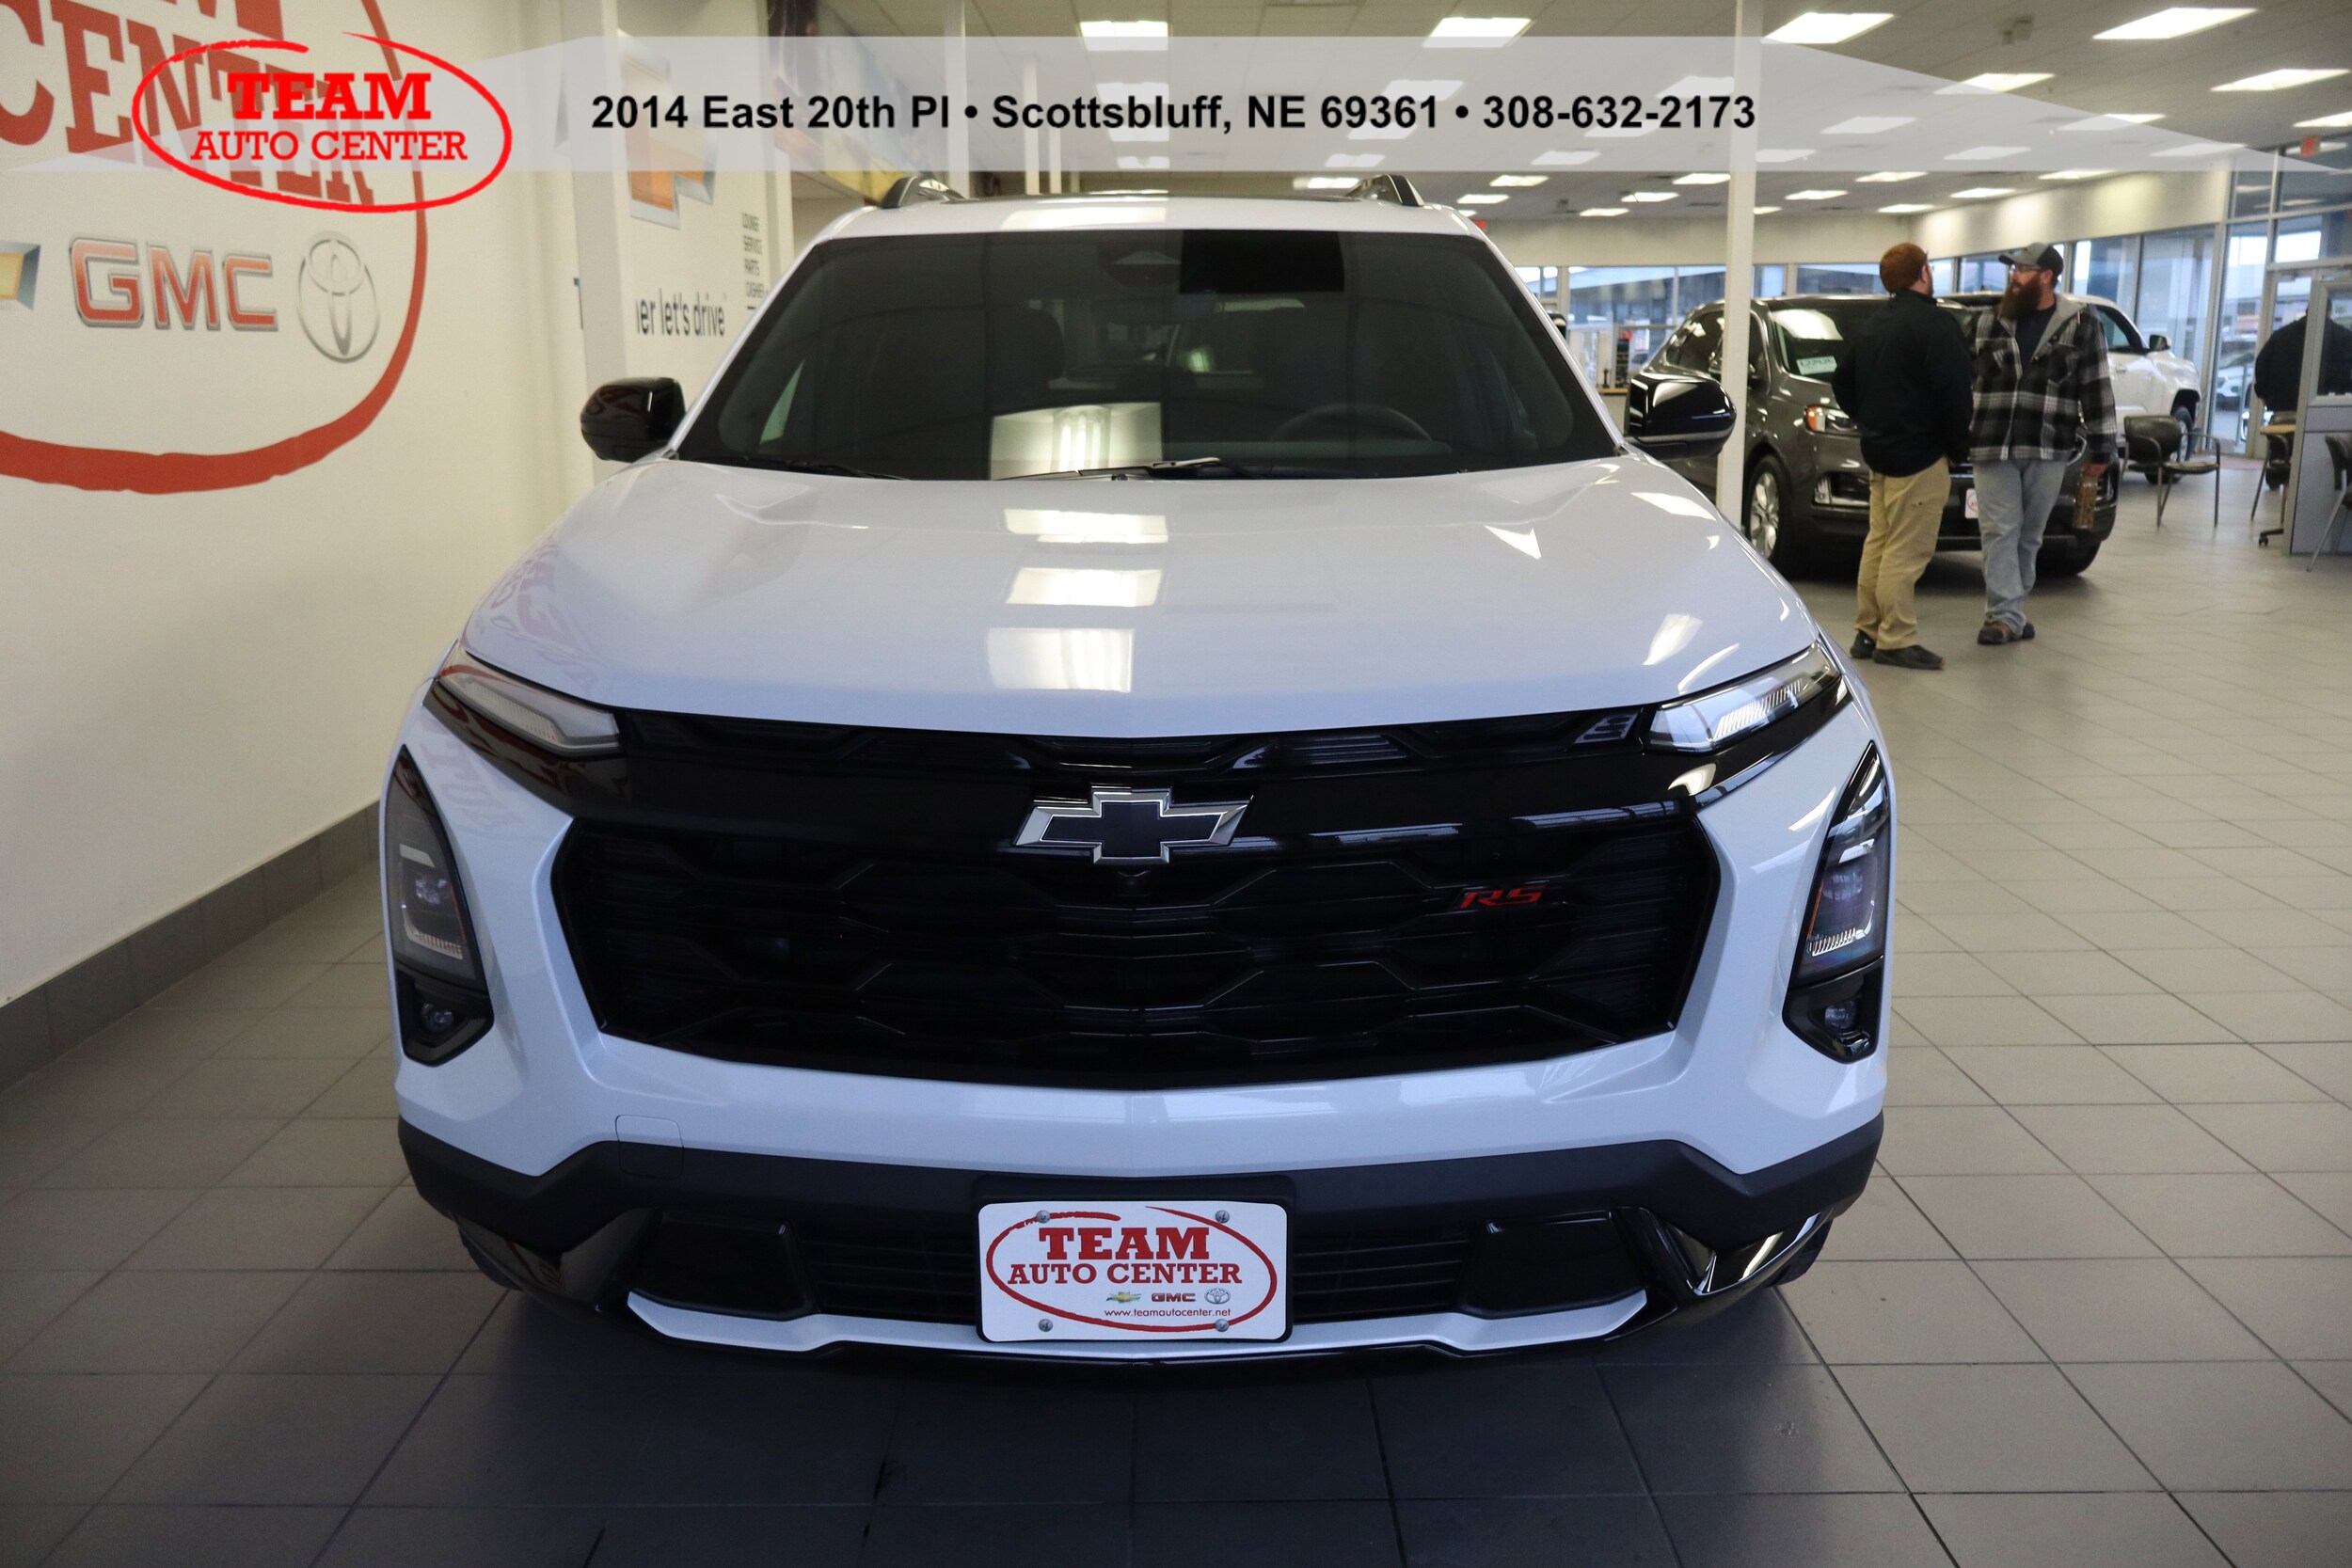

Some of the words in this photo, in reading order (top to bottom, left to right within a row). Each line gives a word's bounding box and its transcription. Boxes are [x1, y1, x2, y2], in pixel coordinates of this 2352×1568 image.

[70, 234, 278, 332] GMC
[660, 288, 691, 337] let's
[693, 292, 726, 337] drive
[1459, 884, 1547, 910] RS
[1039, 1227, 1210, 1260] TEAM
[1008, 1263, 1098, 1285] AUTO
[1106, 1263, 1243, 1285] CENTER
[1151, 1292, 1197, 1303] GMC
[1104, 1307, 1232, 1318] www.teamautocenter.net
